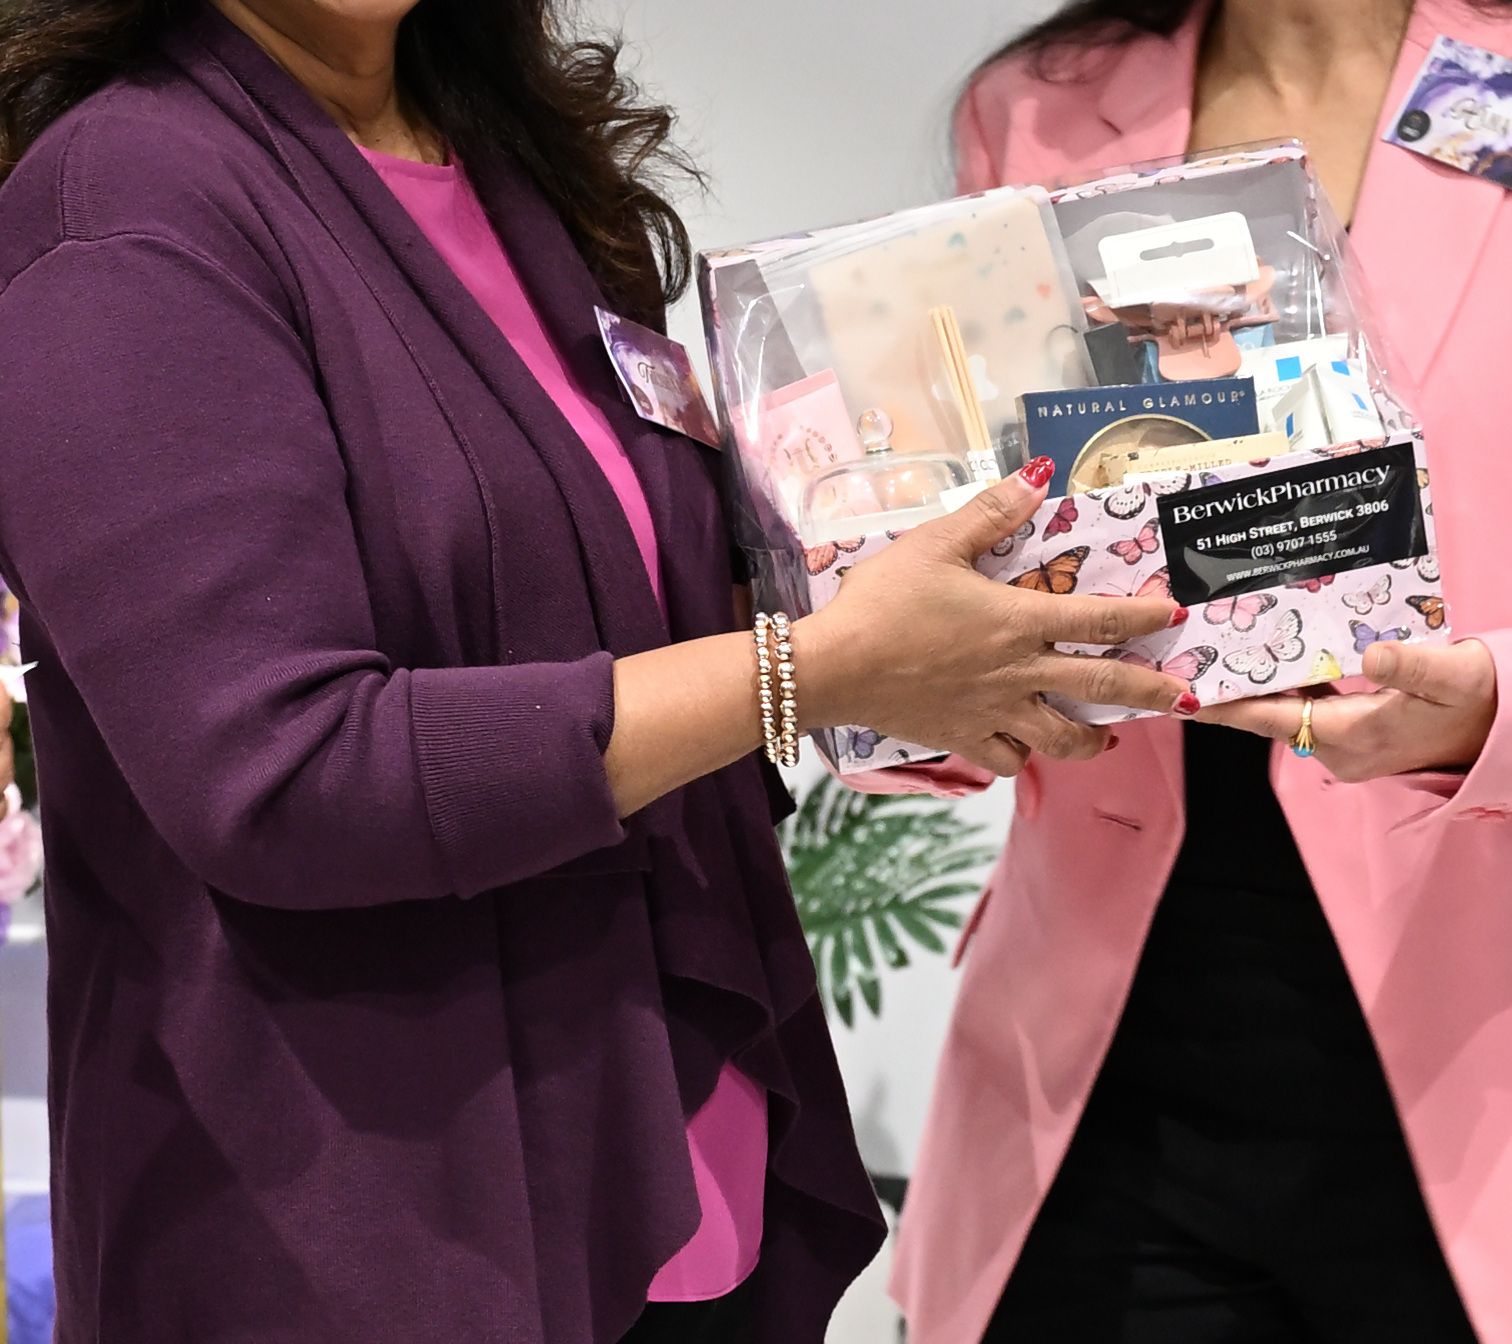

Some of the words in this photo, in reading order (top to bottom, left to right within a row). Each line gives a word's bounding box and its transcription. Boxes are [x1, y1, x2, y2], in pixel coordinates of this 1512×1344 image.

[1037, 400, 1127, 419] NATURAL
[1173, 464, 1391, 524] BerwickPharmacy
[1196, 537, 1212, 551] 51
[1215, 531, 1247, 549] HIGH
[1300, 509, 1354, 530] BERWICK
[1356, 499, 1390, 518] 3806
[1251, 542, 1274, 560] (03)
[1276, 537, 1304, 553] 9707
[1309, 530, 1338, 547] 1555
